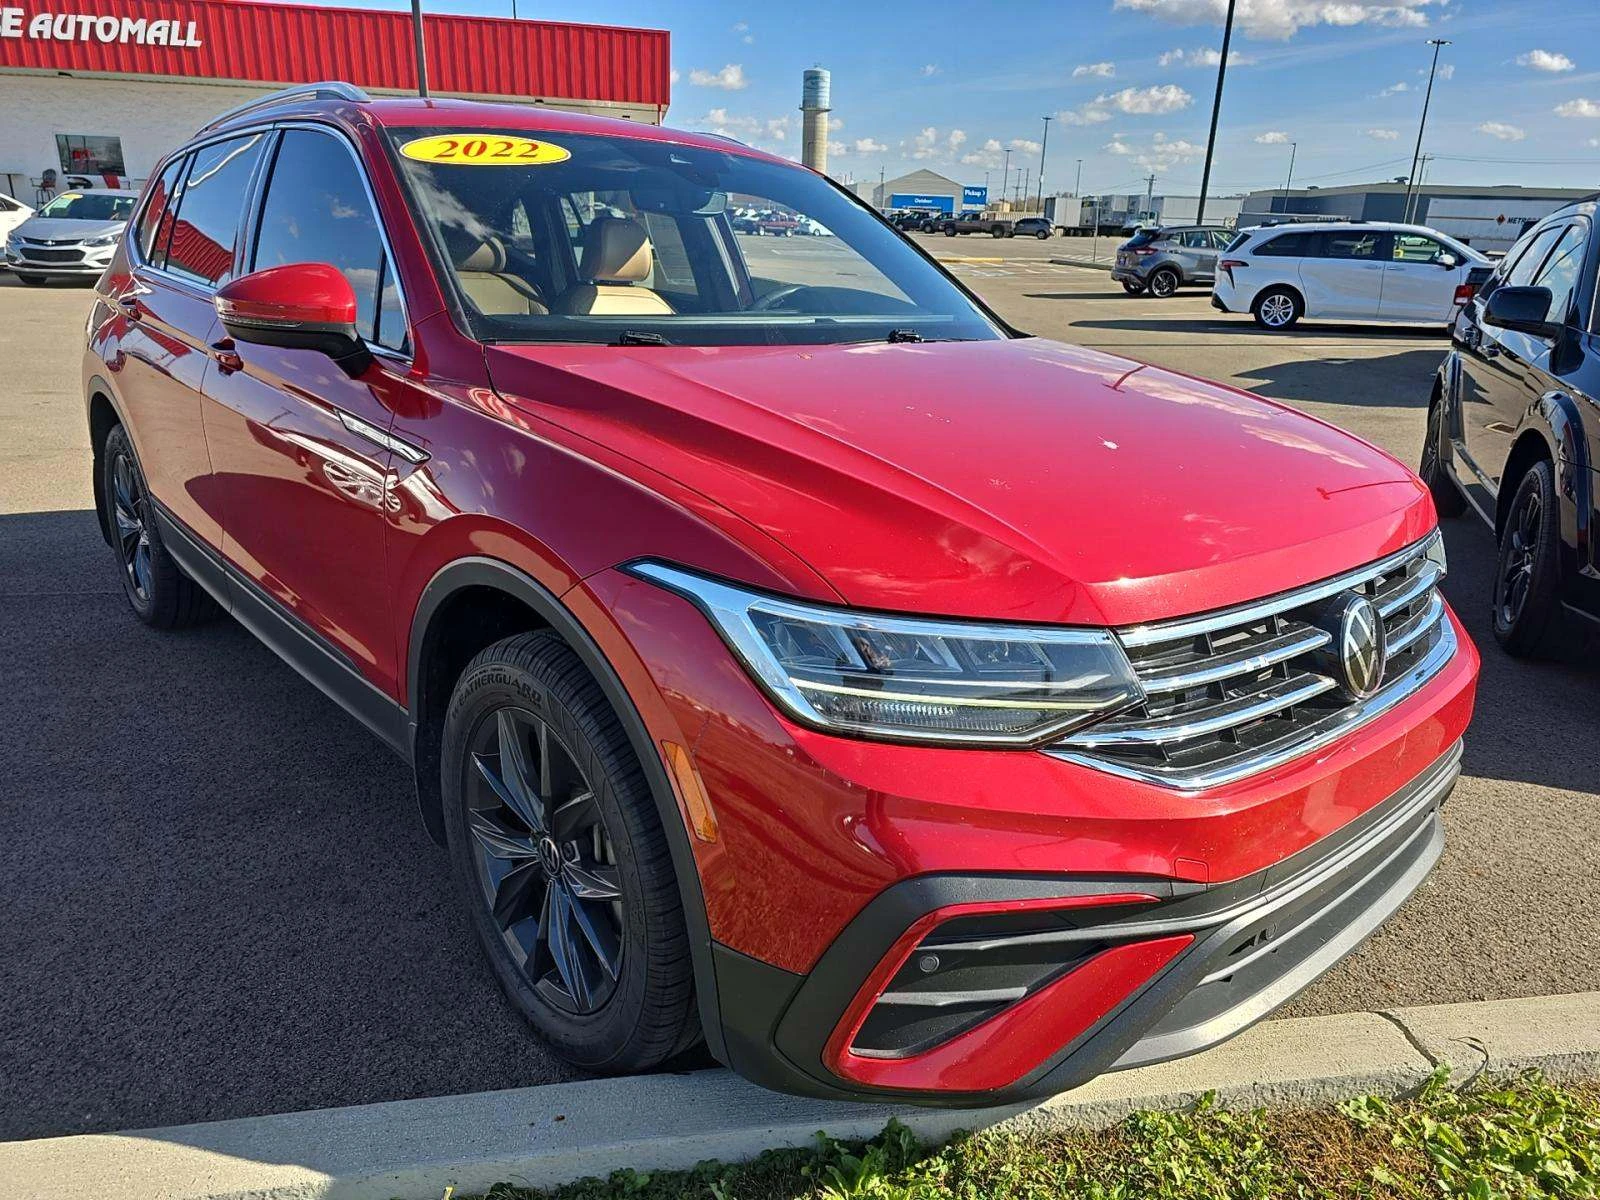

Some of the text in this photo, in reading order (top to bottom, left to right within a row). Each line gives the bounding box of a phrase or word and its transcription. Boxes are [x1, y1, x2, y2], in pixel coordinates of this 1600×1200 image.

[0, 8, 203, 48] E AUTOMALL
[433, 140, 540, 158] 2022
[964, 188, 982, 197] Pickup
